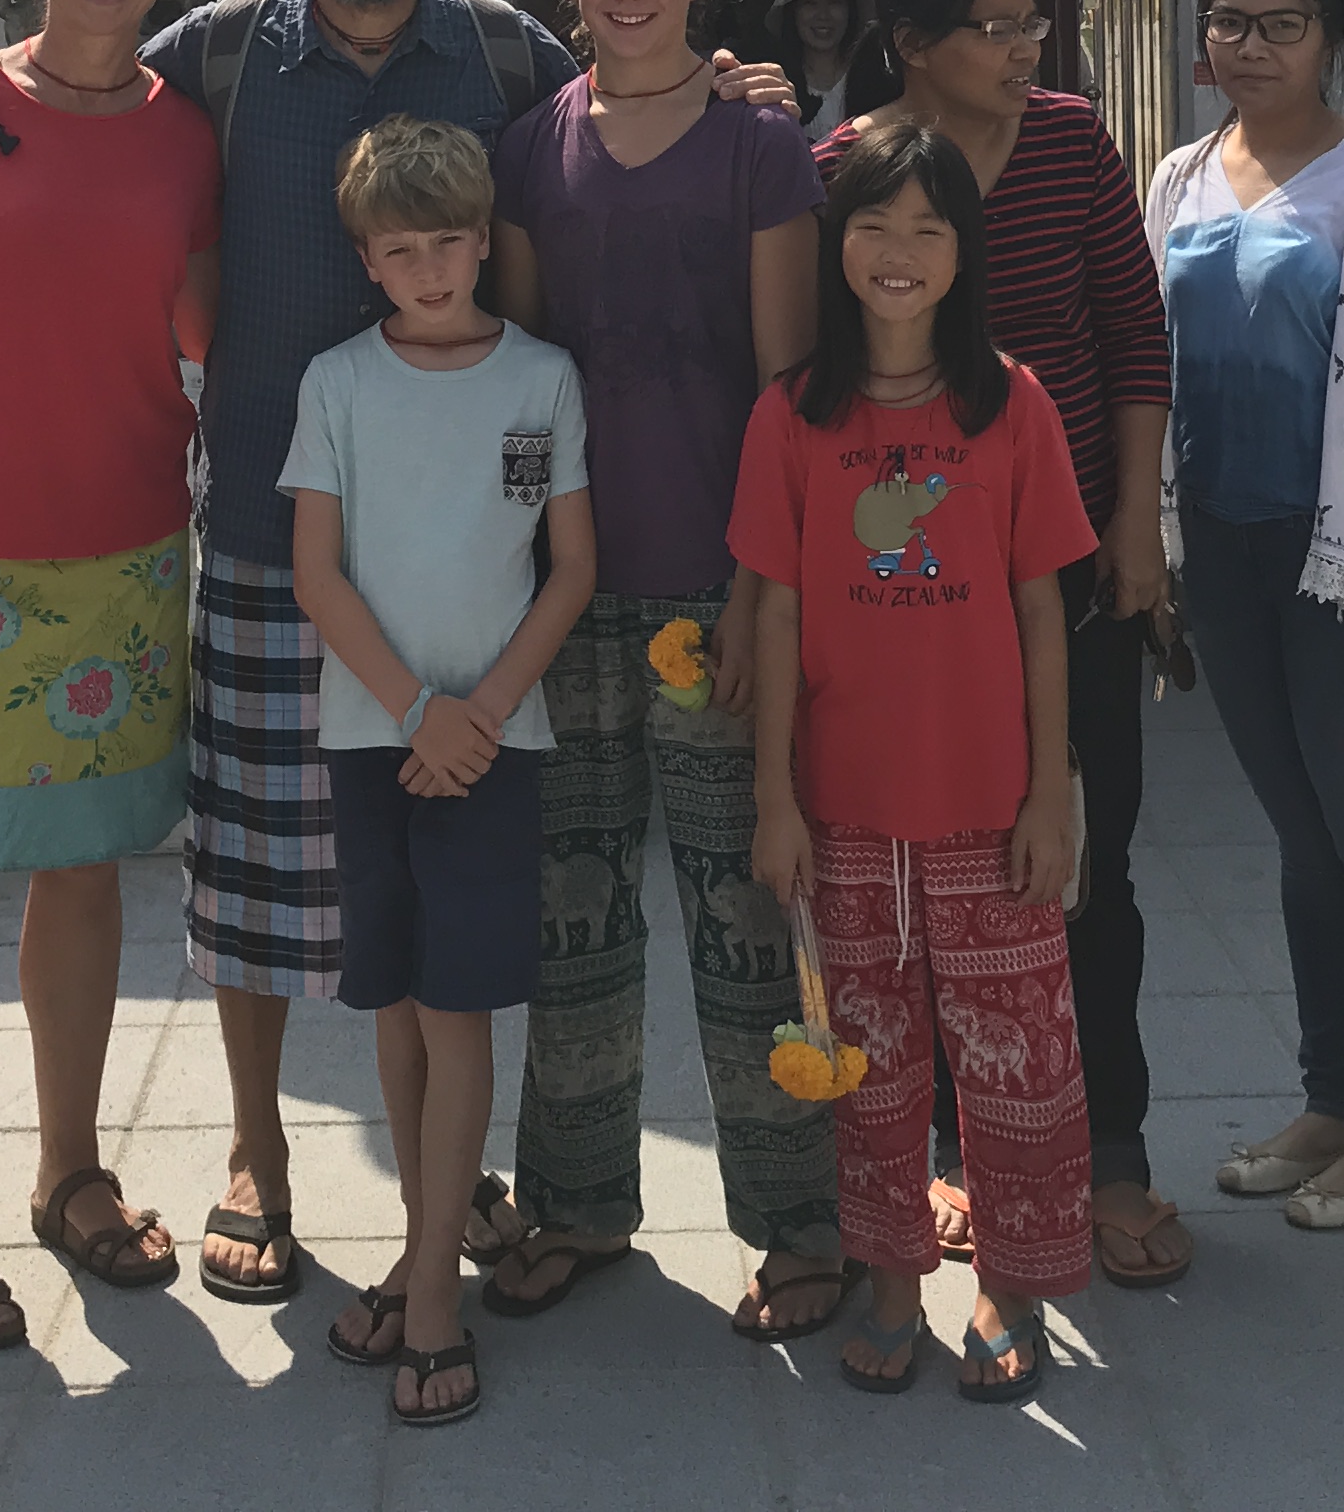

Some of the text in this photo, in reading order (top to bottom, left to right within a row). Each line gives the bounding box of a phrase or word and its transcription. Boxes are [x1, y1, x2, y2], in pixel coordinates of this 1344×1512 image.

[911, 444, 928, 461] BE
[935, 446, 969, 464] WILD
[849, 581, 970, 607] NEW ZEALAND
